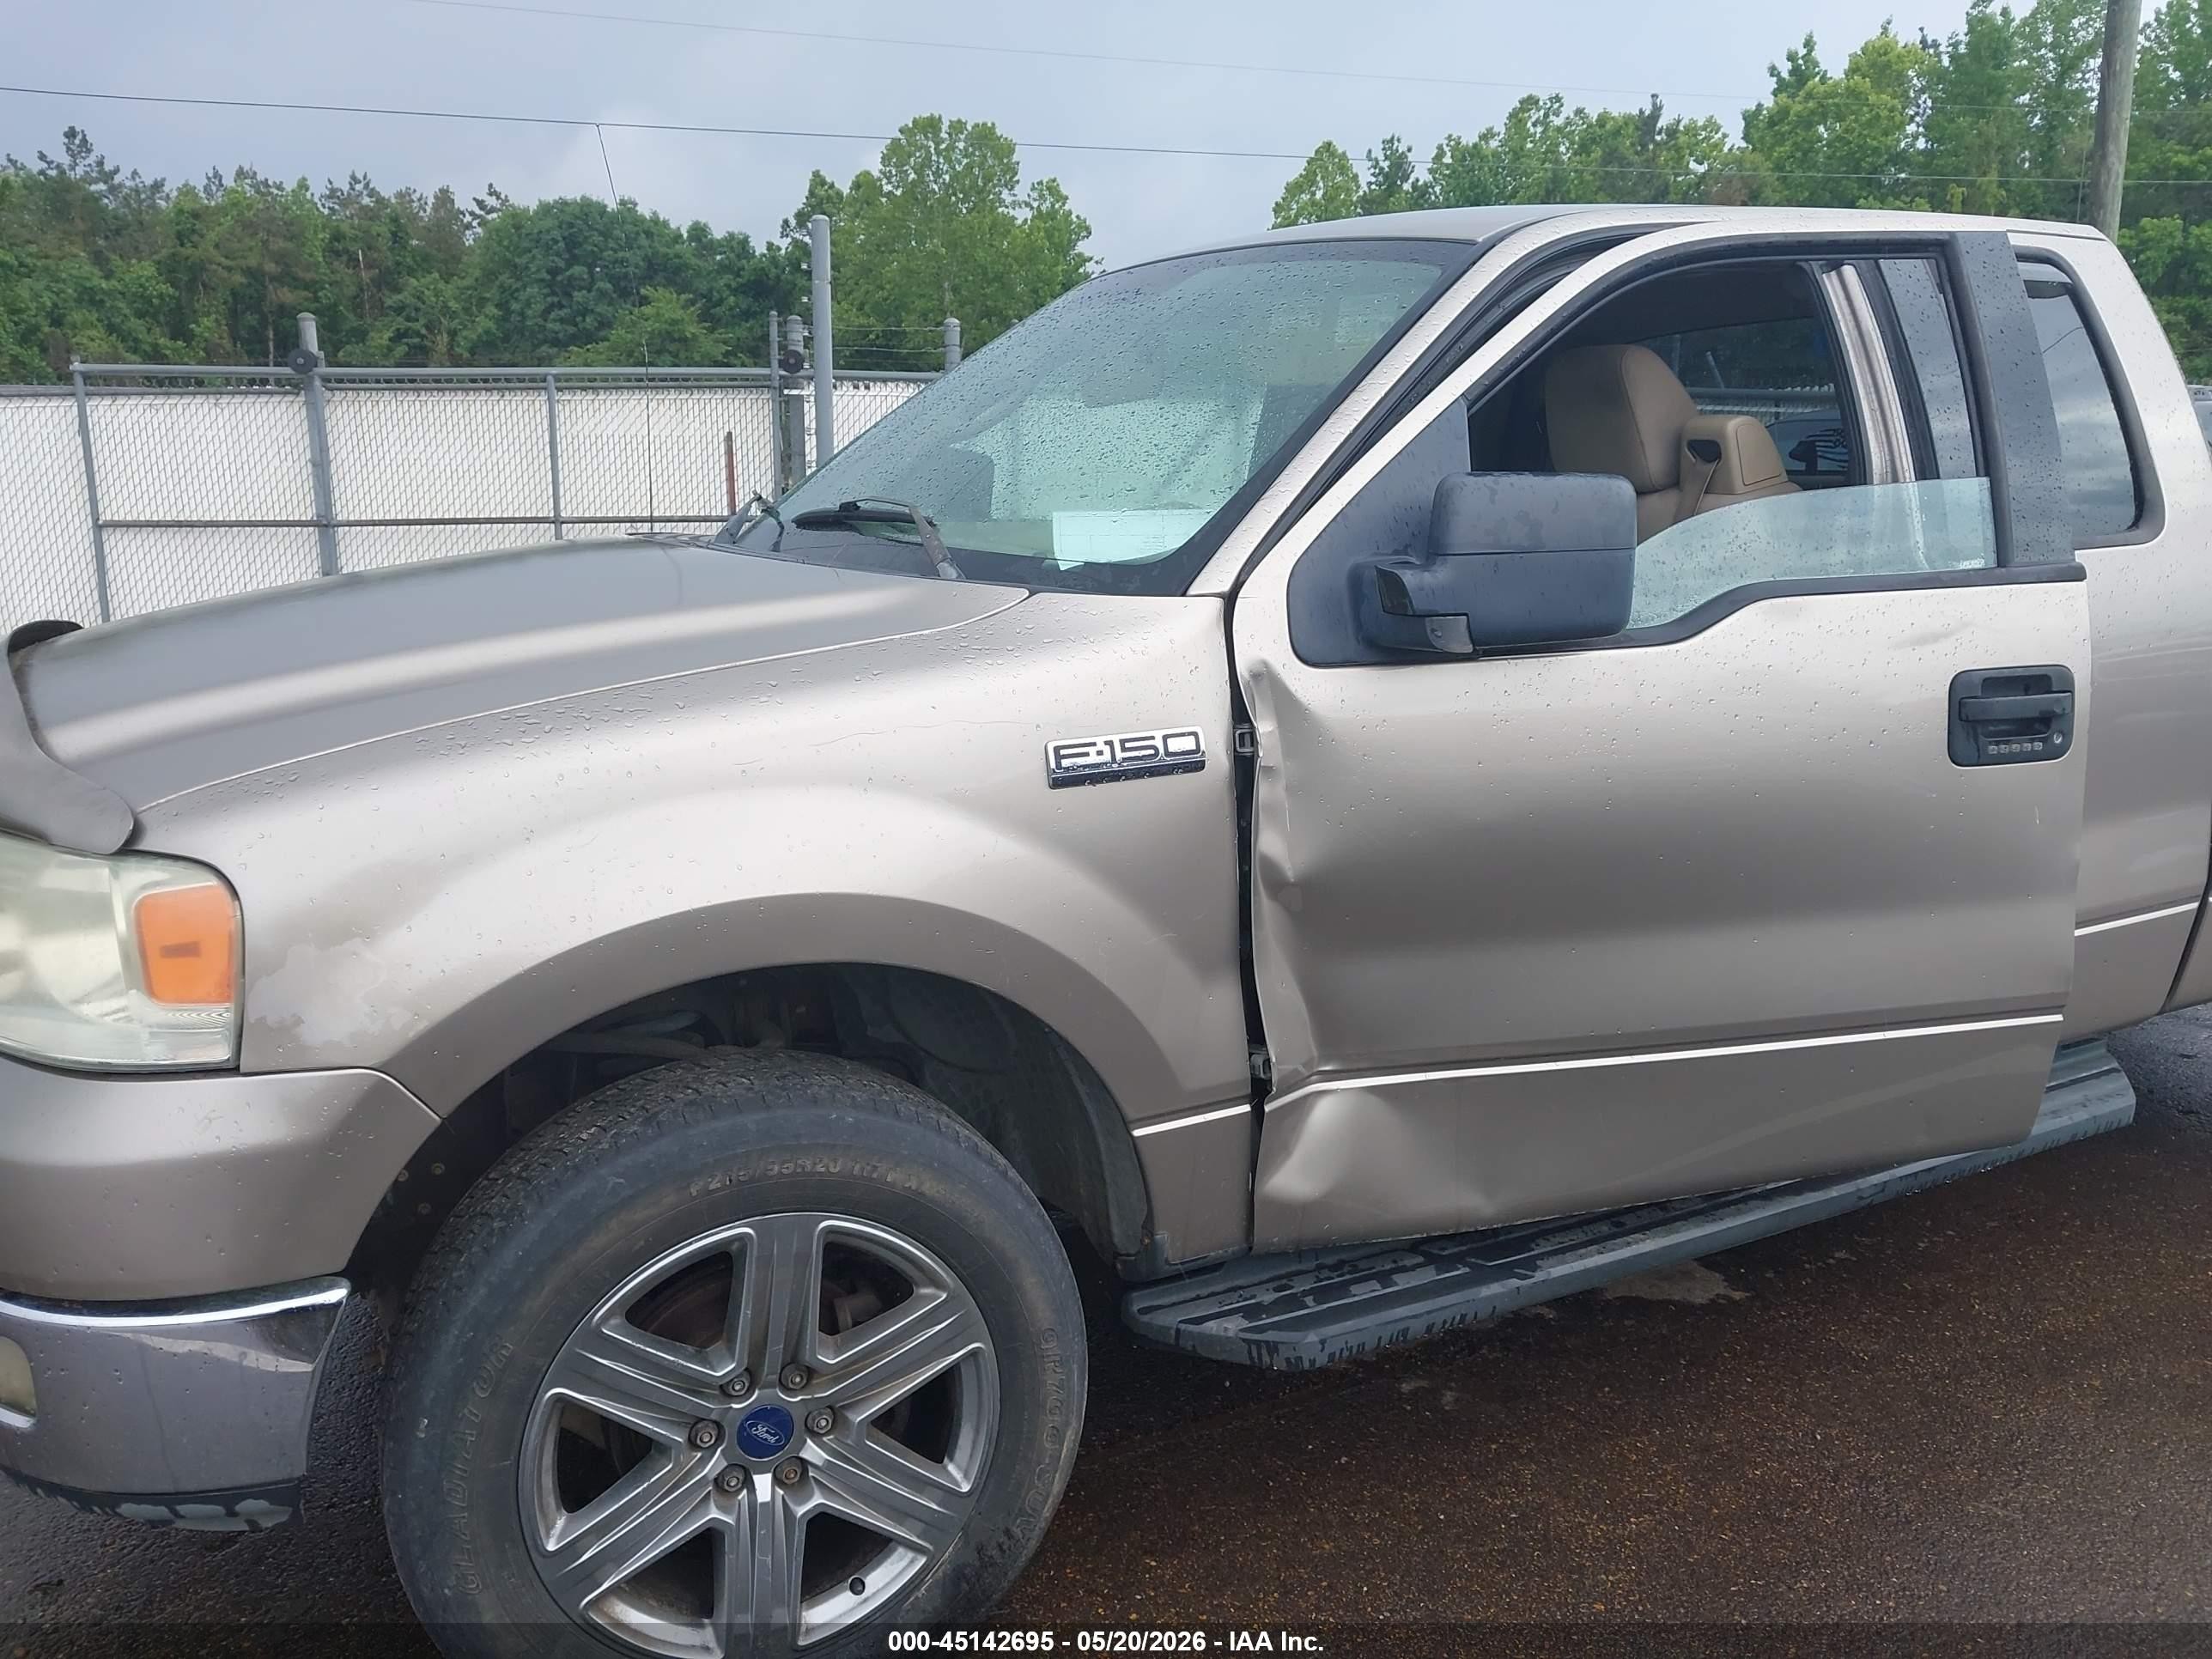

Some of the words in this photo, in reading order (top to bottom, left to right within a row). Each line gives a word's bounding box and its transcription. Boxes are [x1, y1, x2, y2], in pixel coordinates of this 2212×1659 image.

[1049, 730, 1203, 774] F-150
[750, 1423, 780, 1443] Ford
[443, 1340, 514, 1595] GLADIATOR
